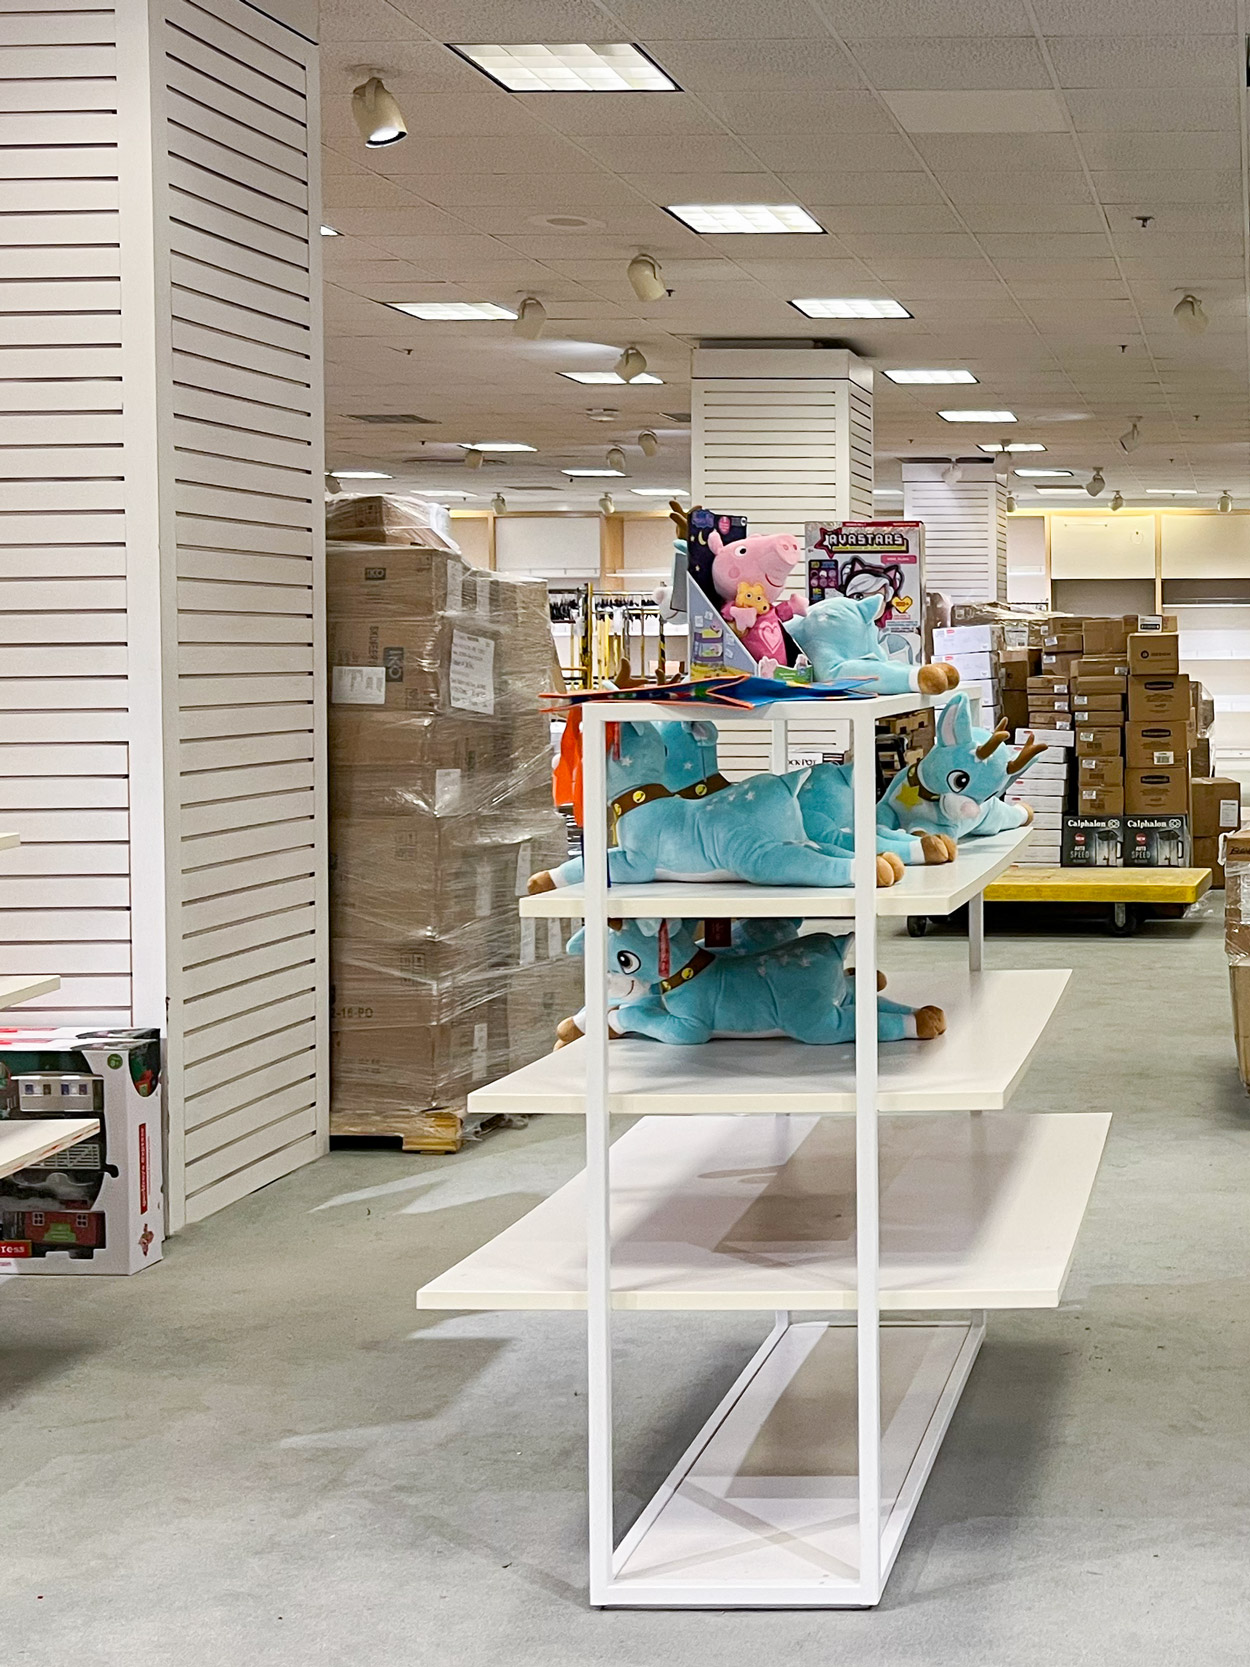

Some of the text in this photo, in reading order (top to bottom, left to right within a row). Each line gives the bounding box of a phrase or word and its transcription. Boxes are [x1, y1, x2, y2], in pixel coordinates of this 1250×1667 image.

[828, 533, 904, 546] AVASTARS
[1067, 819, 1106, 828] Calphalon
[1127, 819, 1167, 828] Calphalon
[1070, 851, 1090, 859] SPEED
[1131, 851, 1151, 859] SPEED
